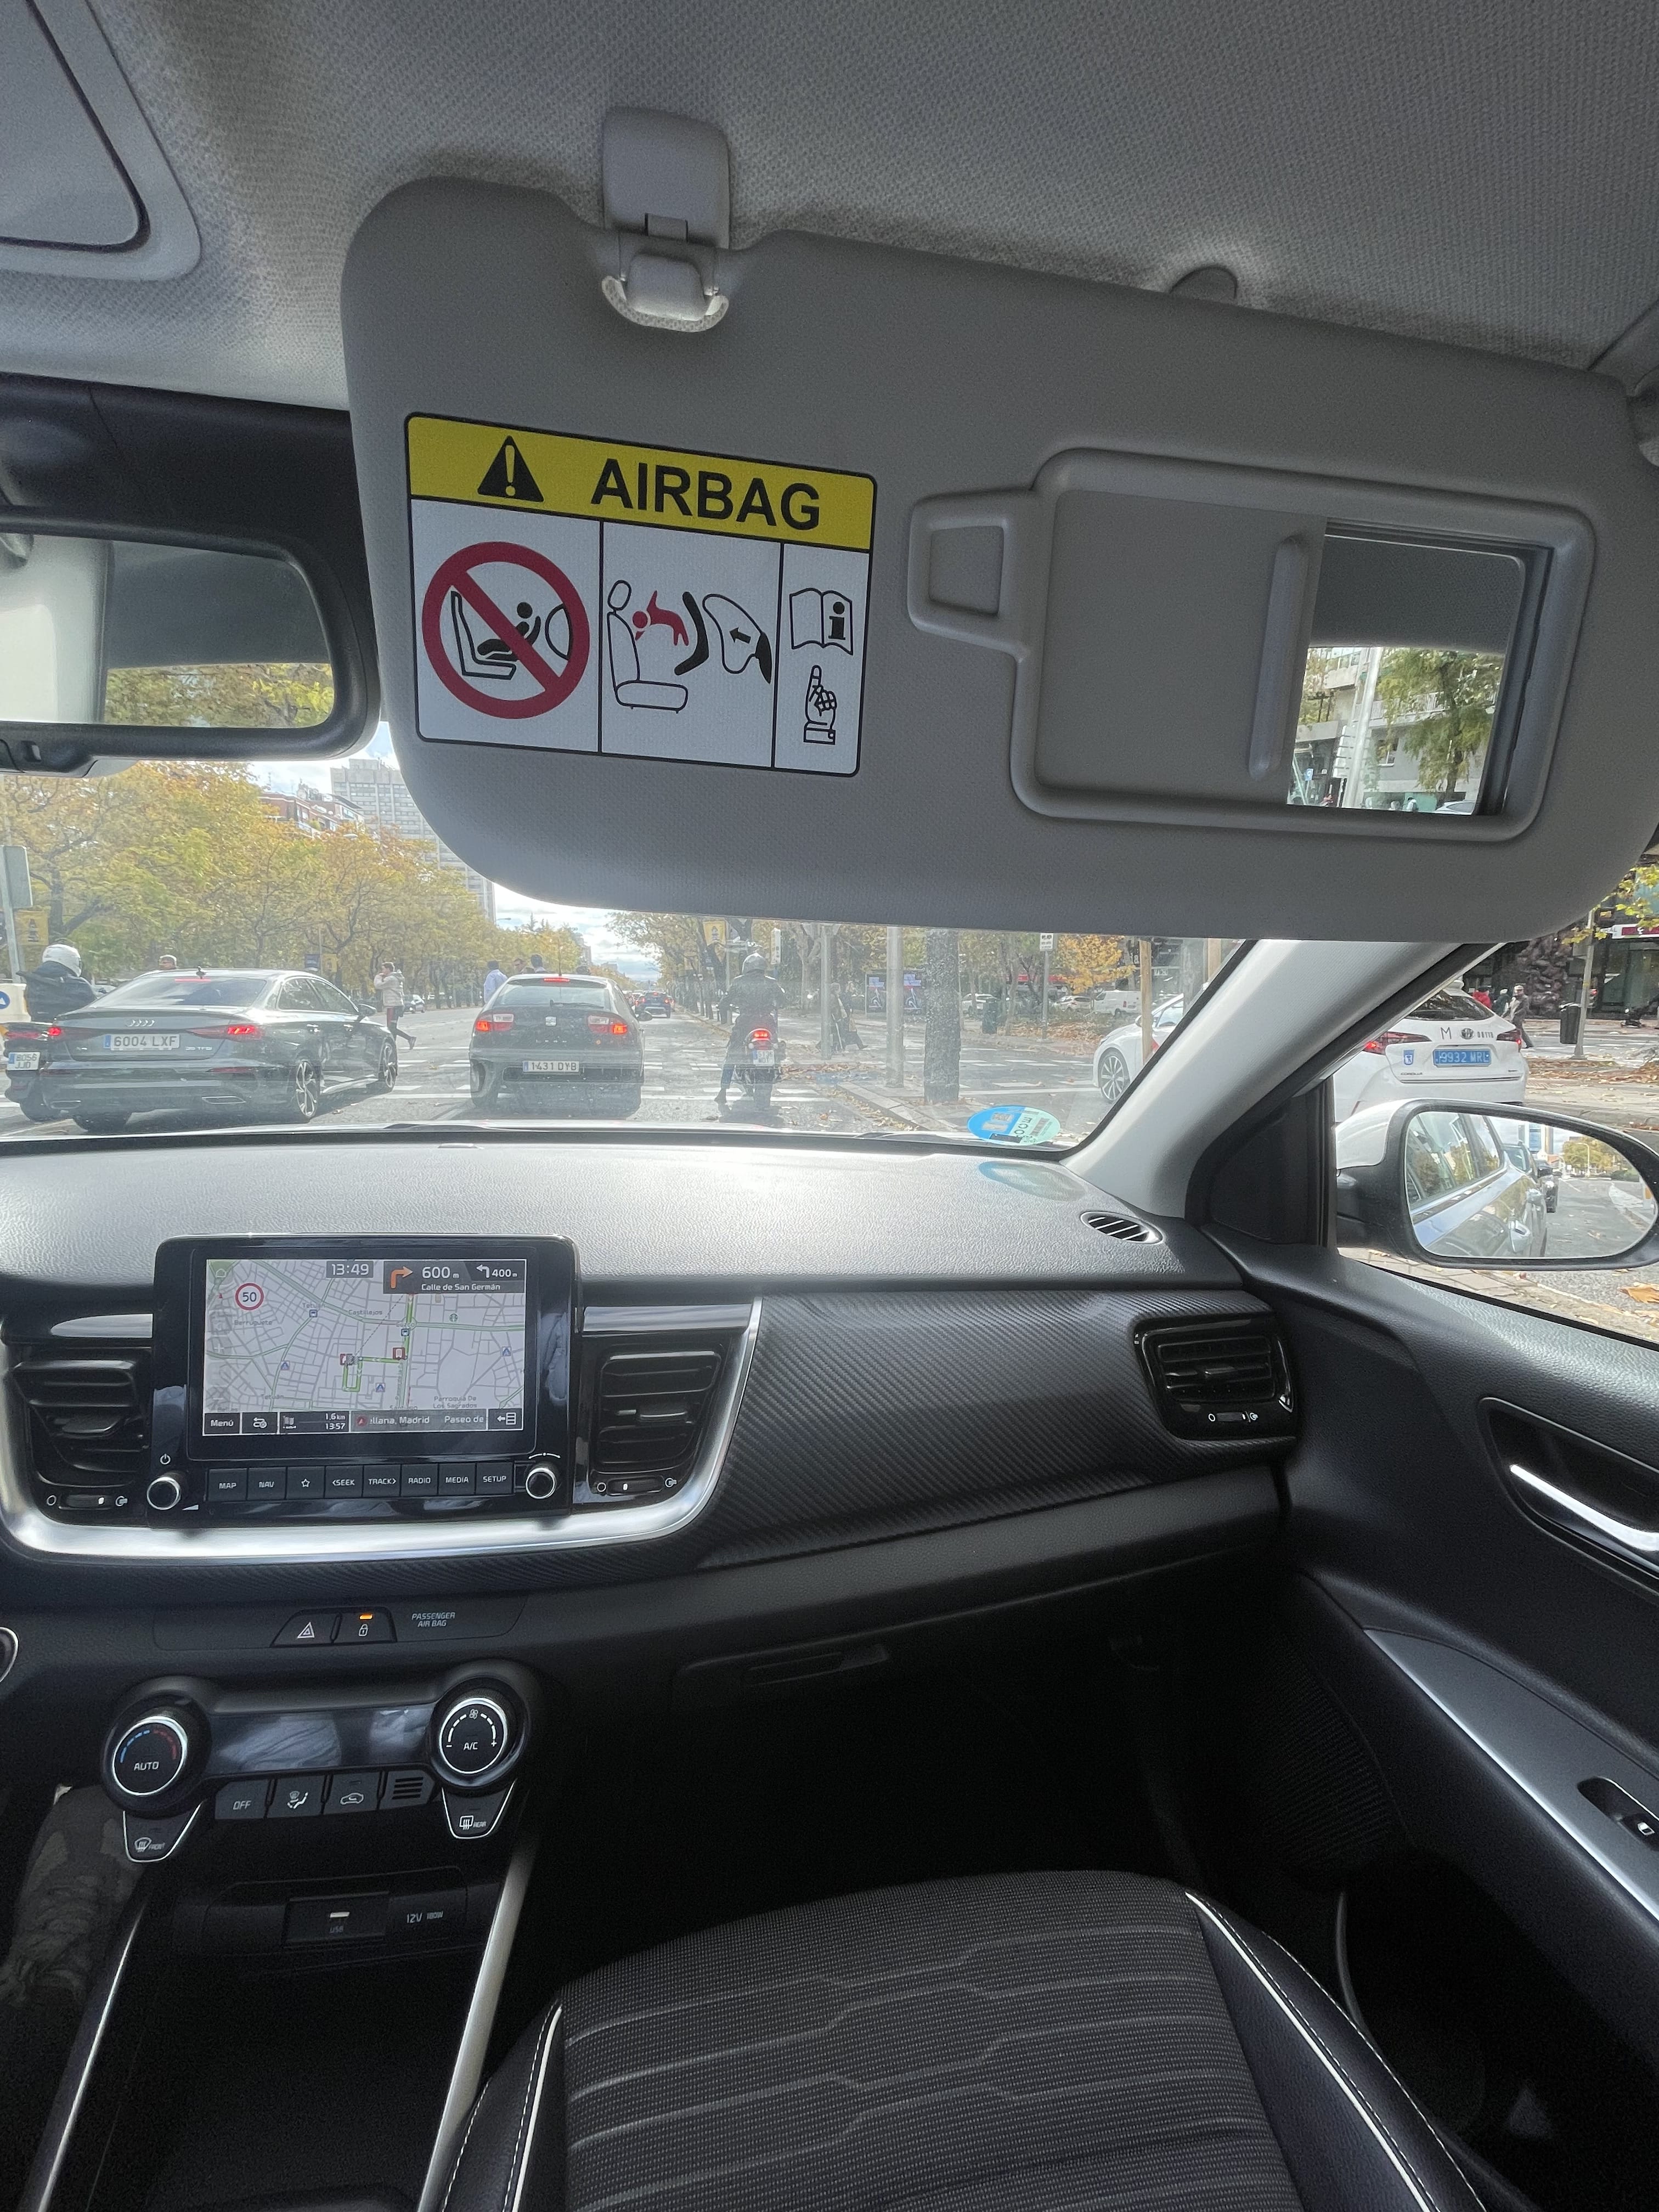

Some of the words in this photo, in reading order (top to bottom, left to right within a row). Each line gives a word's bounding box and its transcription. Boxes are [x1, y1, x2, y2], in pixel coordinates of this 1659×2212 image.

[591, 458, 821, 531] AIRBAG
[1440, 1027, 1452, 1040] M
[113, 1036, 147, 1047] 6004
[152, 1036, 177, 1046] LXF
[1441, 1052, 1466, 1063] 9932
[532, 1062, 554, 1070] 1431
[557, 1062, 577, 1071] DYB
[331, 1263, 369, 1276] 13:49
[422, 1266, 450, 1279] 600
[242, 1292, 257, 1302] 50
[399, 1415, 430, 1424] Madrid
[473, 1415, 484, 1423] de
[411, 1612, 455, 1621] PASSENGER
[463, 1742, 478, 1751] A/C
[134, 1761, 159, 1771] AUTO
[233, 1800, 251, 1810] OFF
[149, 1842, 165, 1850] FRONT
[407, 1912, 422, 1923] 12V
[330, 1925, 343, 1933] USB
